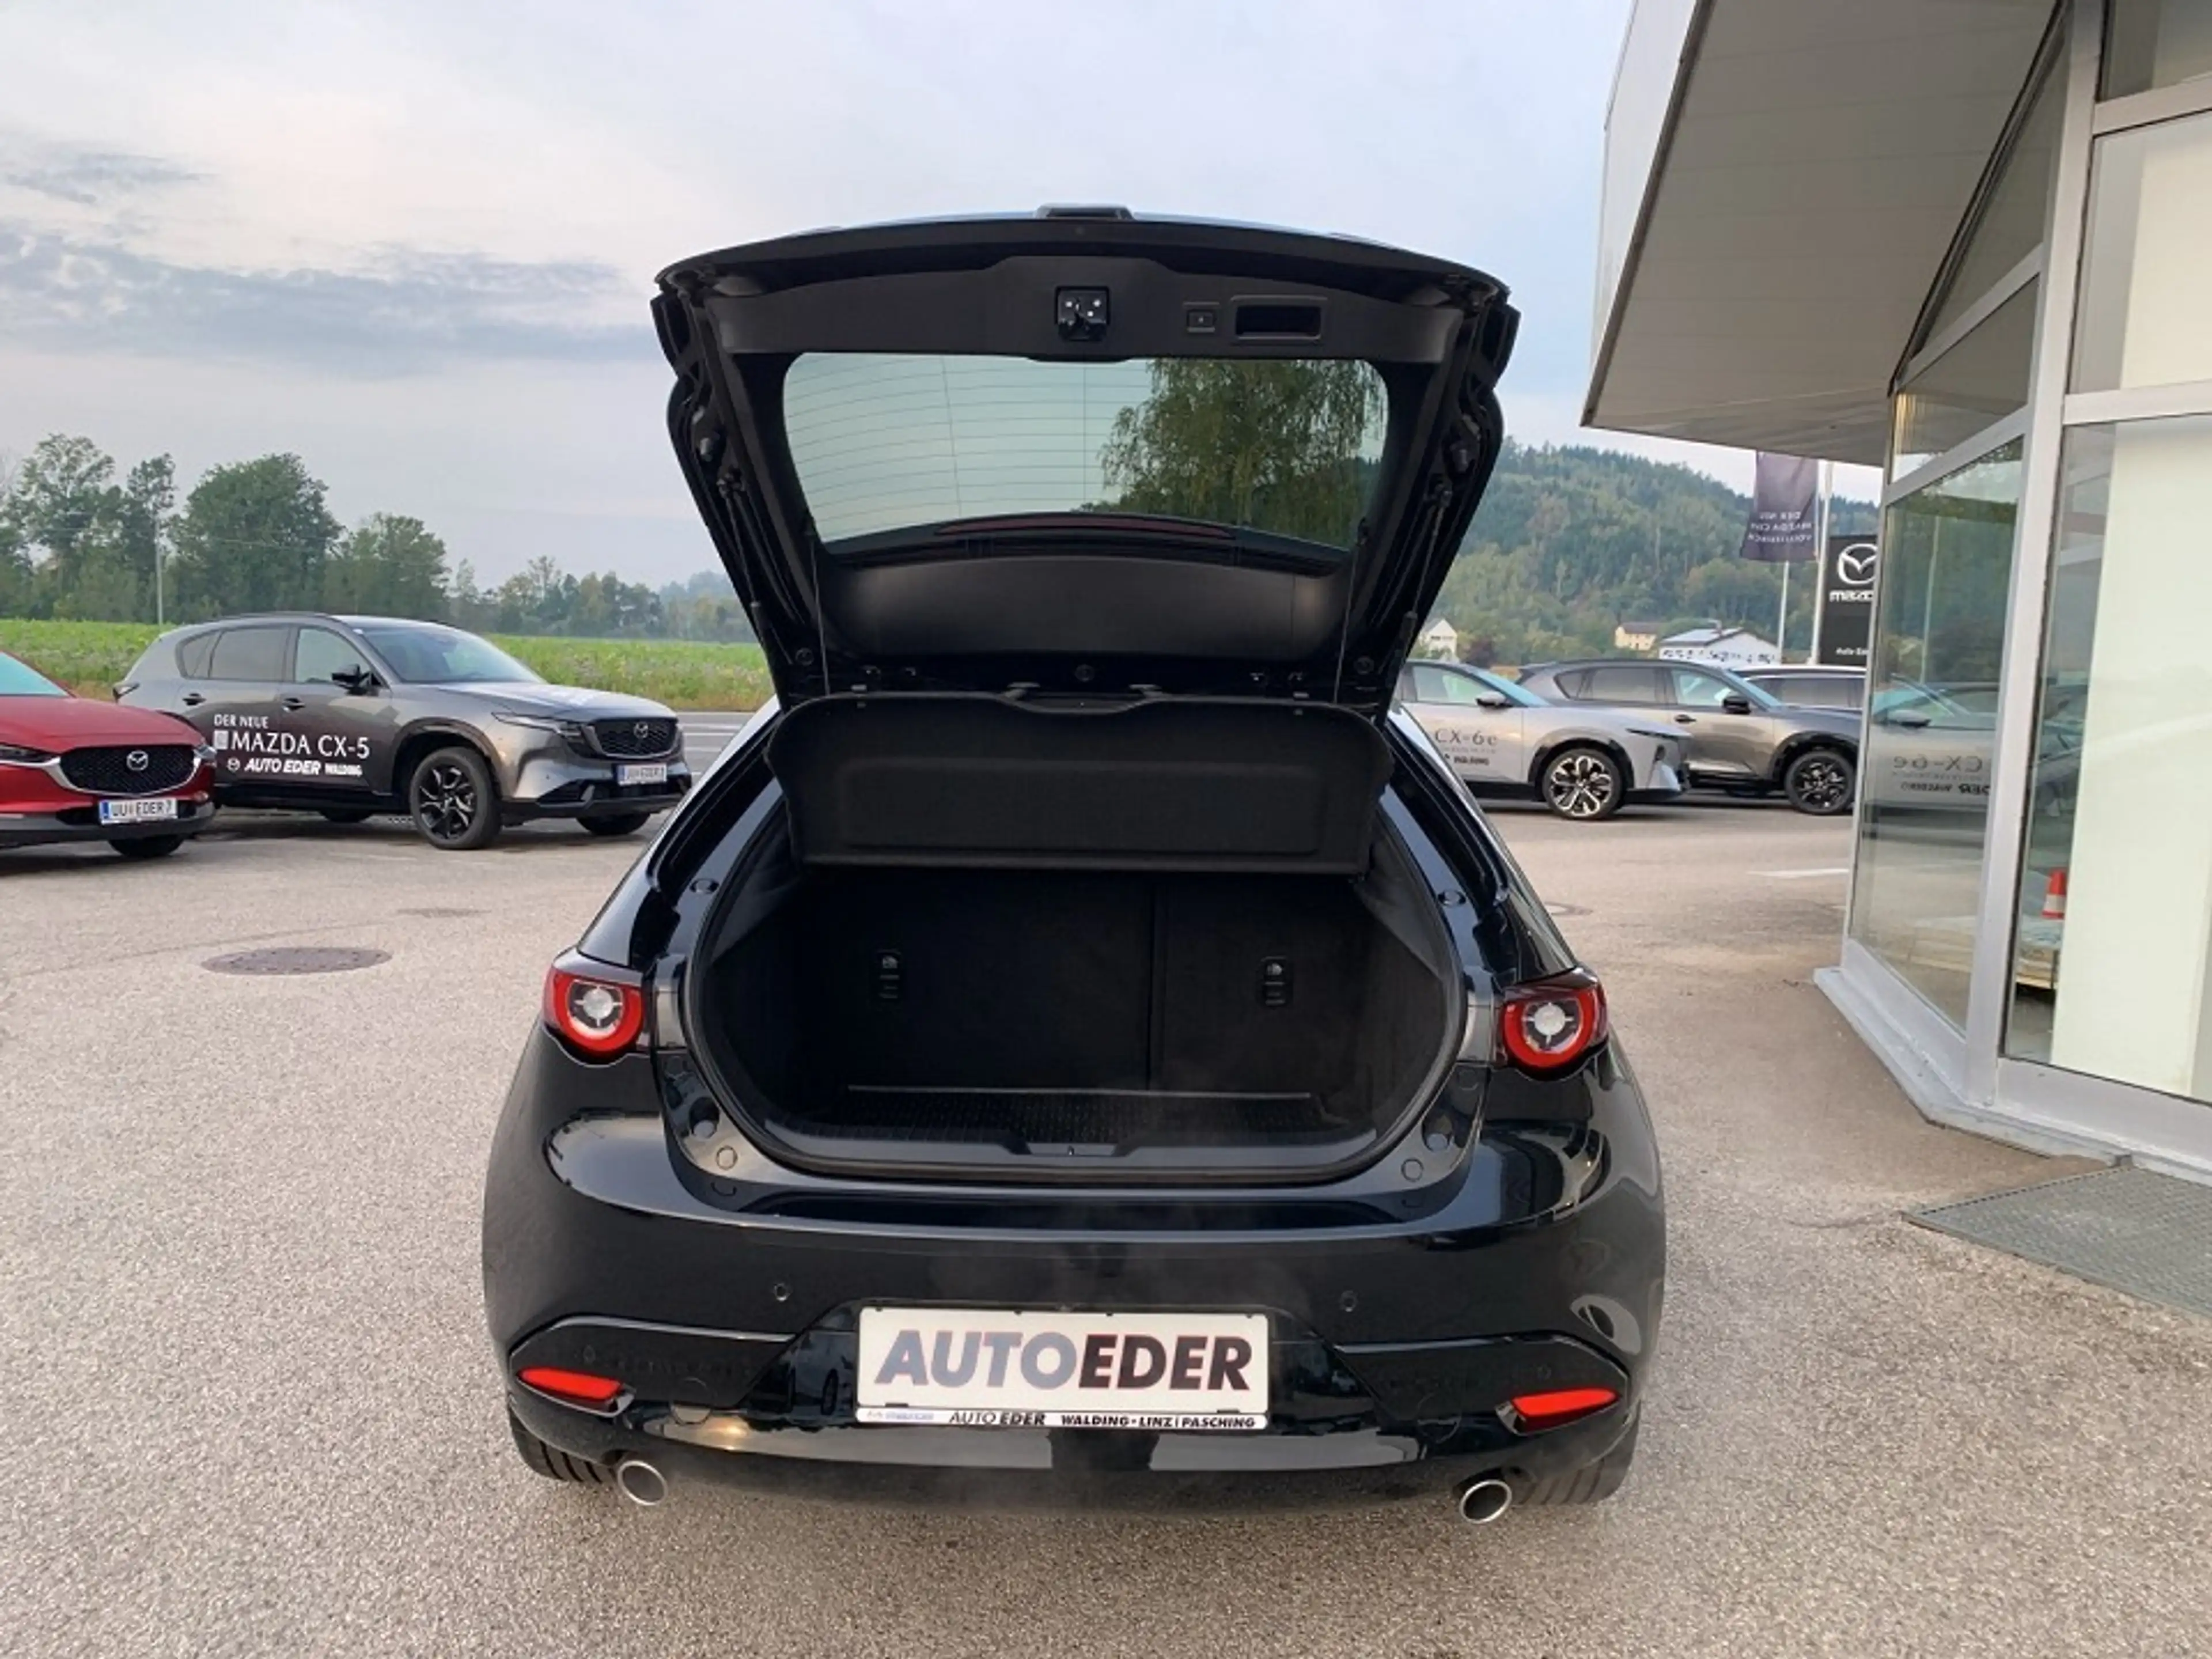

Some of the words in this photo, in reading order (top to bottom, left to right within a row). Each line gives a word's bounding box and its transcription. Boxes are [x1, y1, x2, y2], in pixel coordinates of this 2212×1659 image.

[214, 714, 236, 726] DER
[231, 730, 311, 755] MAZDA
[317, 734, 370, 759] CX-5
[244, 757, 282, 773] AUTO
[283, 759, 321, 775] EDER
[874, 1328, 1253, 1392] AUTOEDER
[949, 1411, 996, 1425] AUTO
[999, 1412, 1047, 1426] EDER
[1061, 1414, 1130, 1428] WALDING
[1139, 1416, 1174, 1428] LINZ
[1182, 1416, 1256, 1429] PASCHING
